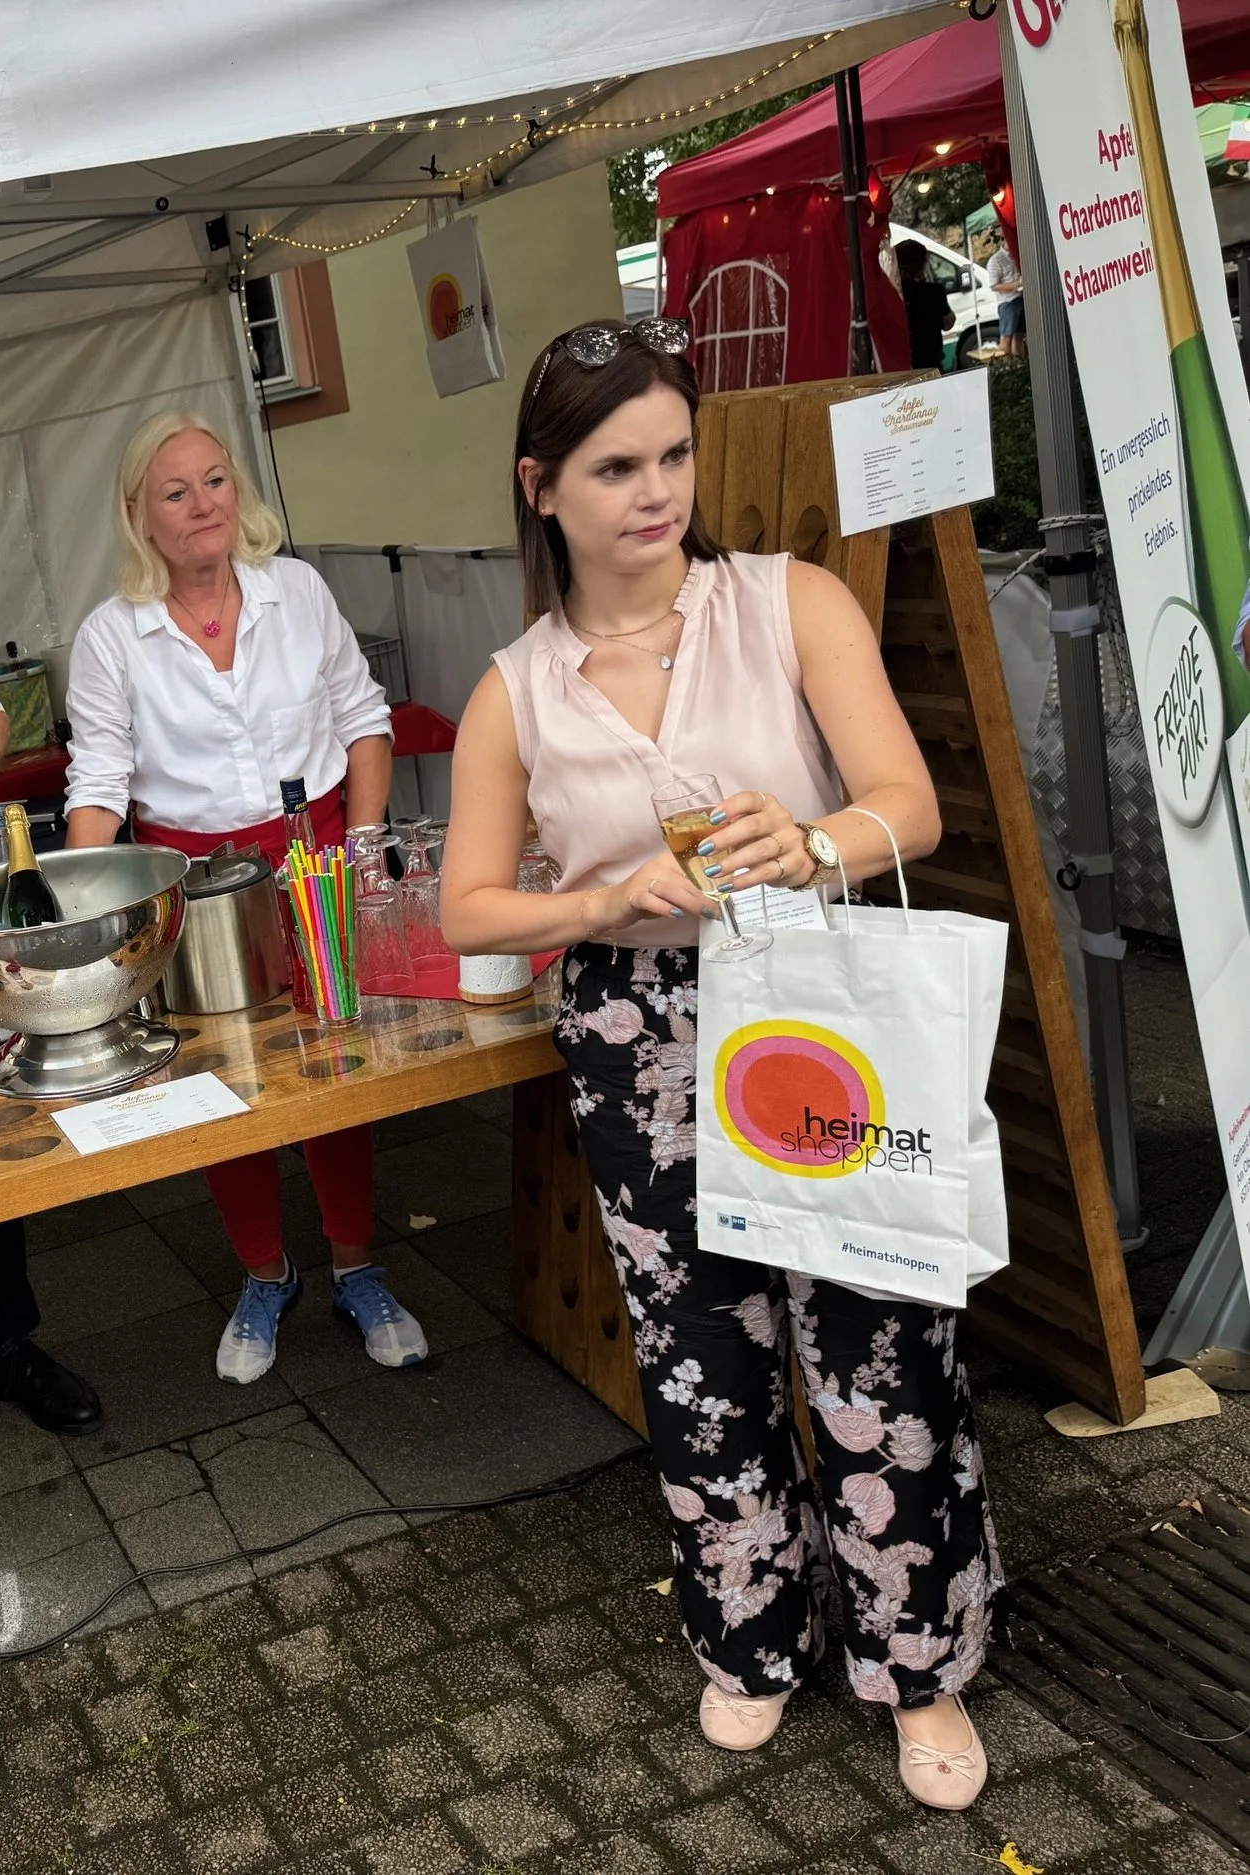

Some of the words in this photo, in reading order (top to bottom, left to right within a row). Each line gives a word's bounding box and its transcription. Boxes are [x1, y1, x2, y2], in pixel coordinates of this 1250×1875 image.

[1063, 241, 1154, 306] Schaumwein
[882, 406, 939, 428] Chardonnay
[896, 396, 924, 413] Apfel
[1100, 449, 1116, 475] Ein
[1117, 412, 1171, 464] unvergesslich
[1128, 468, 1172, 522] prickelndes
[1144, 518, 1178, 557] Erlebnis.
[1154, 625, 1203, 768] FREUDE
[1177, 687, 1208, 801] PUR!
[780, 1126, 932, 1176] shoppen
[804, 1106, 932, 1154] heimat
[841, 1242, 940, 1274] #heimatshoppen
